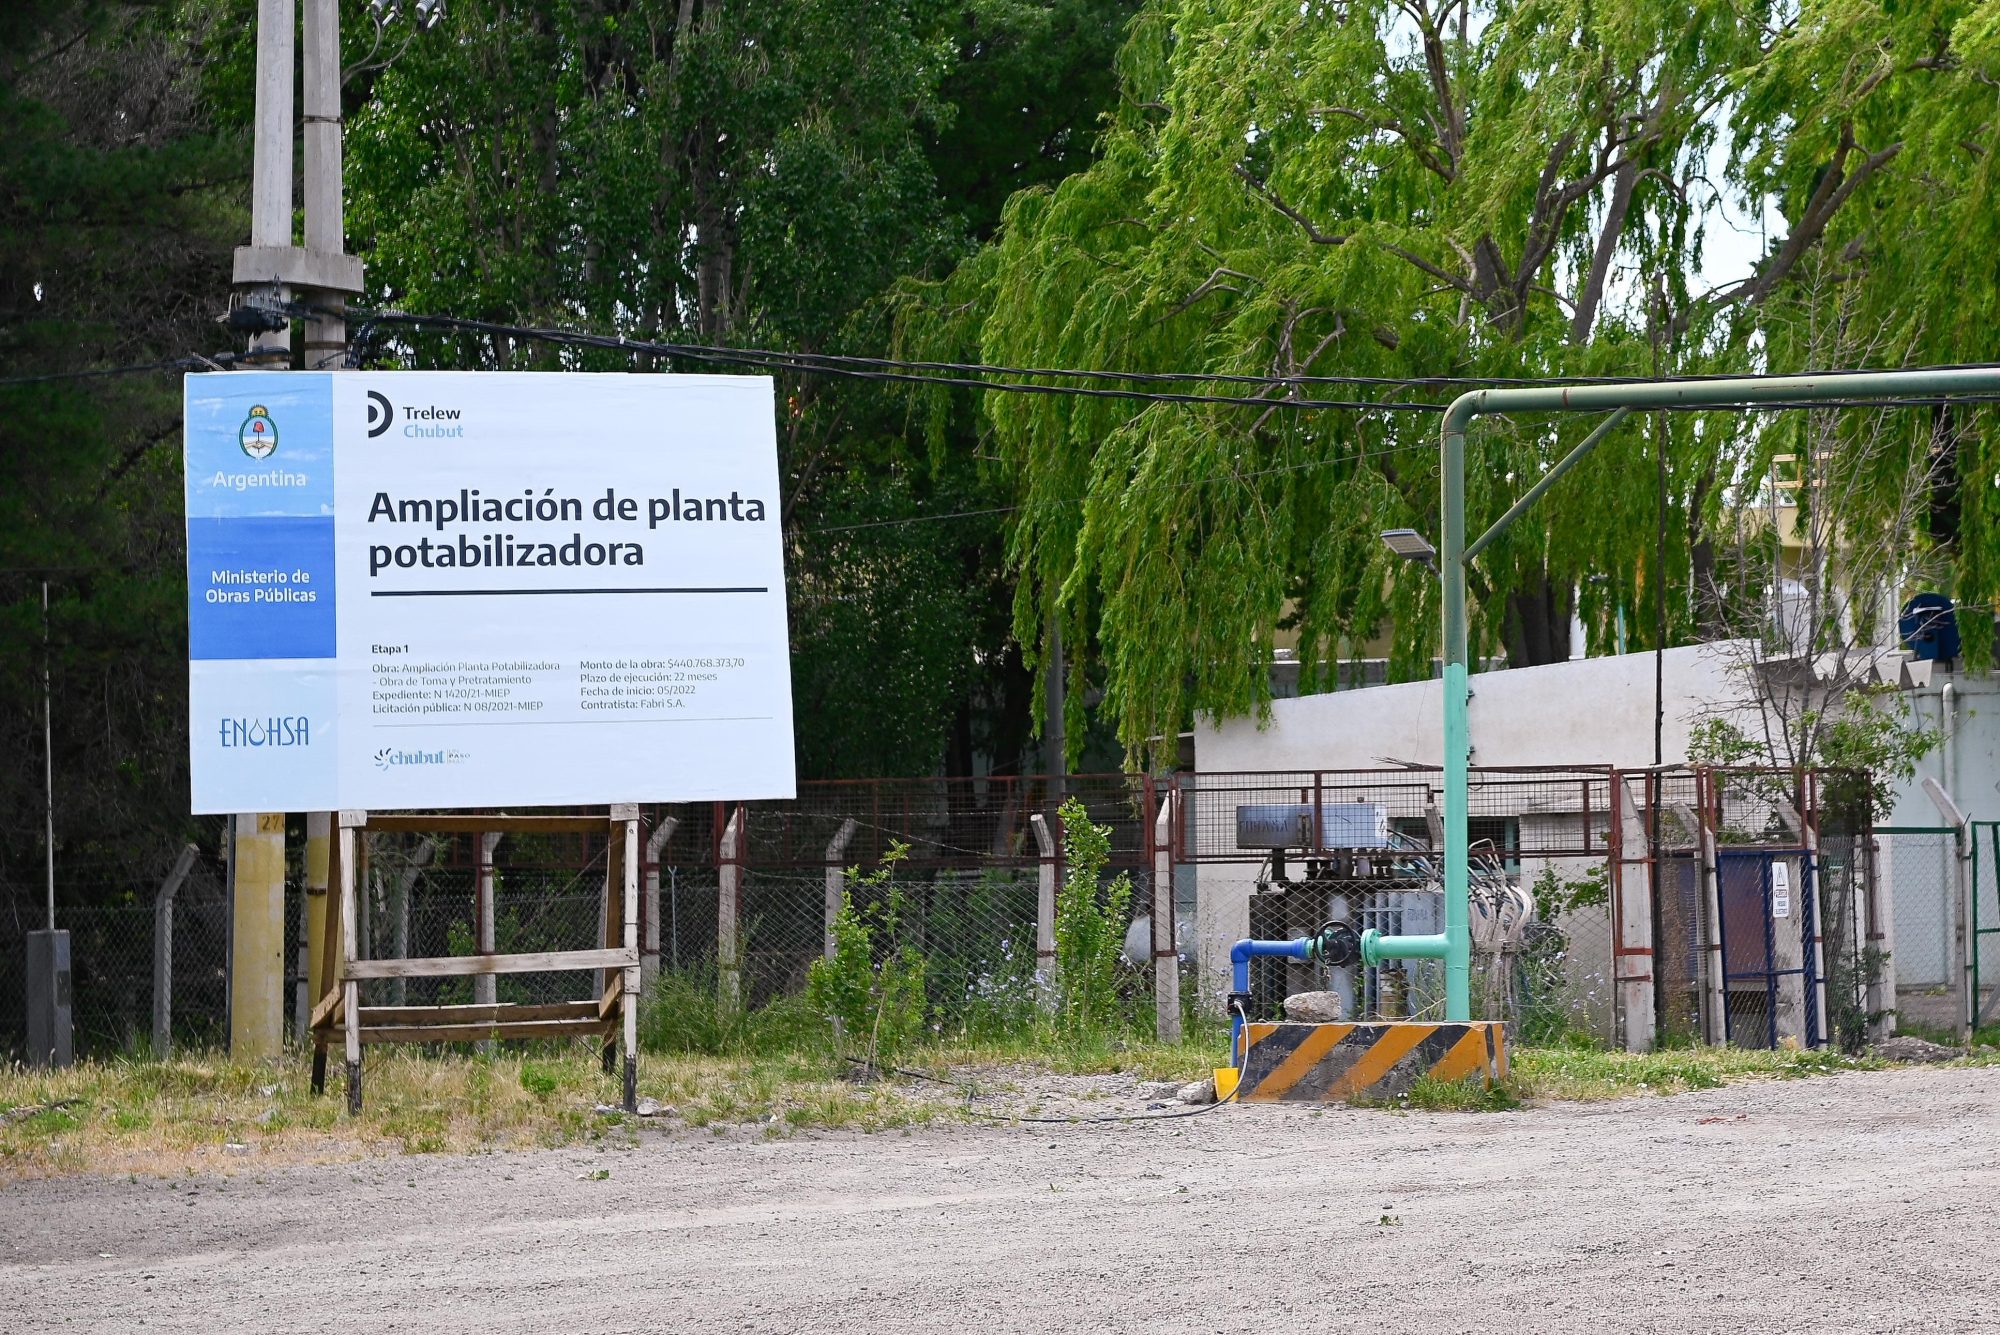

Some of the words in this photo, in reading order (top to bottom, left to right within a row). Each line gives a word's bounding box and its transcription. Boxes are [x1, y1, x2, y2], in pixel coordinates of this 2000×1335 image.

[403, 405, 461, 420] Trelew
[403, 423, 463, 438] Chubut
[213, 470, 306, 492] Argentina
[367, 488, 582, 530] Ampliación
[592, 488, 638, 521] de
[649, 488, 766, 530] planta
[370, 533, 644, 577] potabilizadora
[211, 569, 287, 585] Ministerio
[291, 568, 310, 584] de
[205, 589, 250, 604] Obras
[255, 587, 316, 603] Públicas
[371, 644, 401, 655] Etapa
[404, 644, 409, 653] 1
[372, 663, 400, 673] Obra:
[402, 662, 455, 675] Ampliación
[458, 662, 489, 672] Planta
[492, 661, 560, 671] Potabilizadora
[580, 660, 613, 670] Monto
[615, 660, 627, 669] de
[629, 659, 638, 669] la
[641, 659, 666, 669] obra:
[667, 658, 745, 669] $440.768.373,70
[379, 677, 403, 687] Obra
[406, 677, 418, 686] de
[421, 677, 447, 686] Toma
[450, 678, 456, 687] y
[458, 675, 532, 685] Pretratamiento
[580, 673, 607, 683] Plazo
[609, 673, 621, 682] de
[624, 672, 672, 684] ejecución:
[674, 672, 685, 682] 22
[687, 672, 718, 682] meses
[373, 690, 431, 702] Expediente:
[445, 688, 511, 699] 1420/21-MIEP
[580, 687, 609, 696] Fecha
[612, 686, 624, 696] de
[626, 686, 655, 695] inicio:
[657, 685, 696, 696] 05/2022
[373, 703, 420, 714] Licitación
[423, 702, 461, 715] pública:
[474, 701, 544, 712] 08/2021-MIEP
[581, 700, 639, 710] Contratista:
[640, 699, 665, 709] Fabri
[667, 698, 685, 708] S.A.
[219, 716, 309, 747] ENOHSA
[389, 750, 444, 765] chubut
